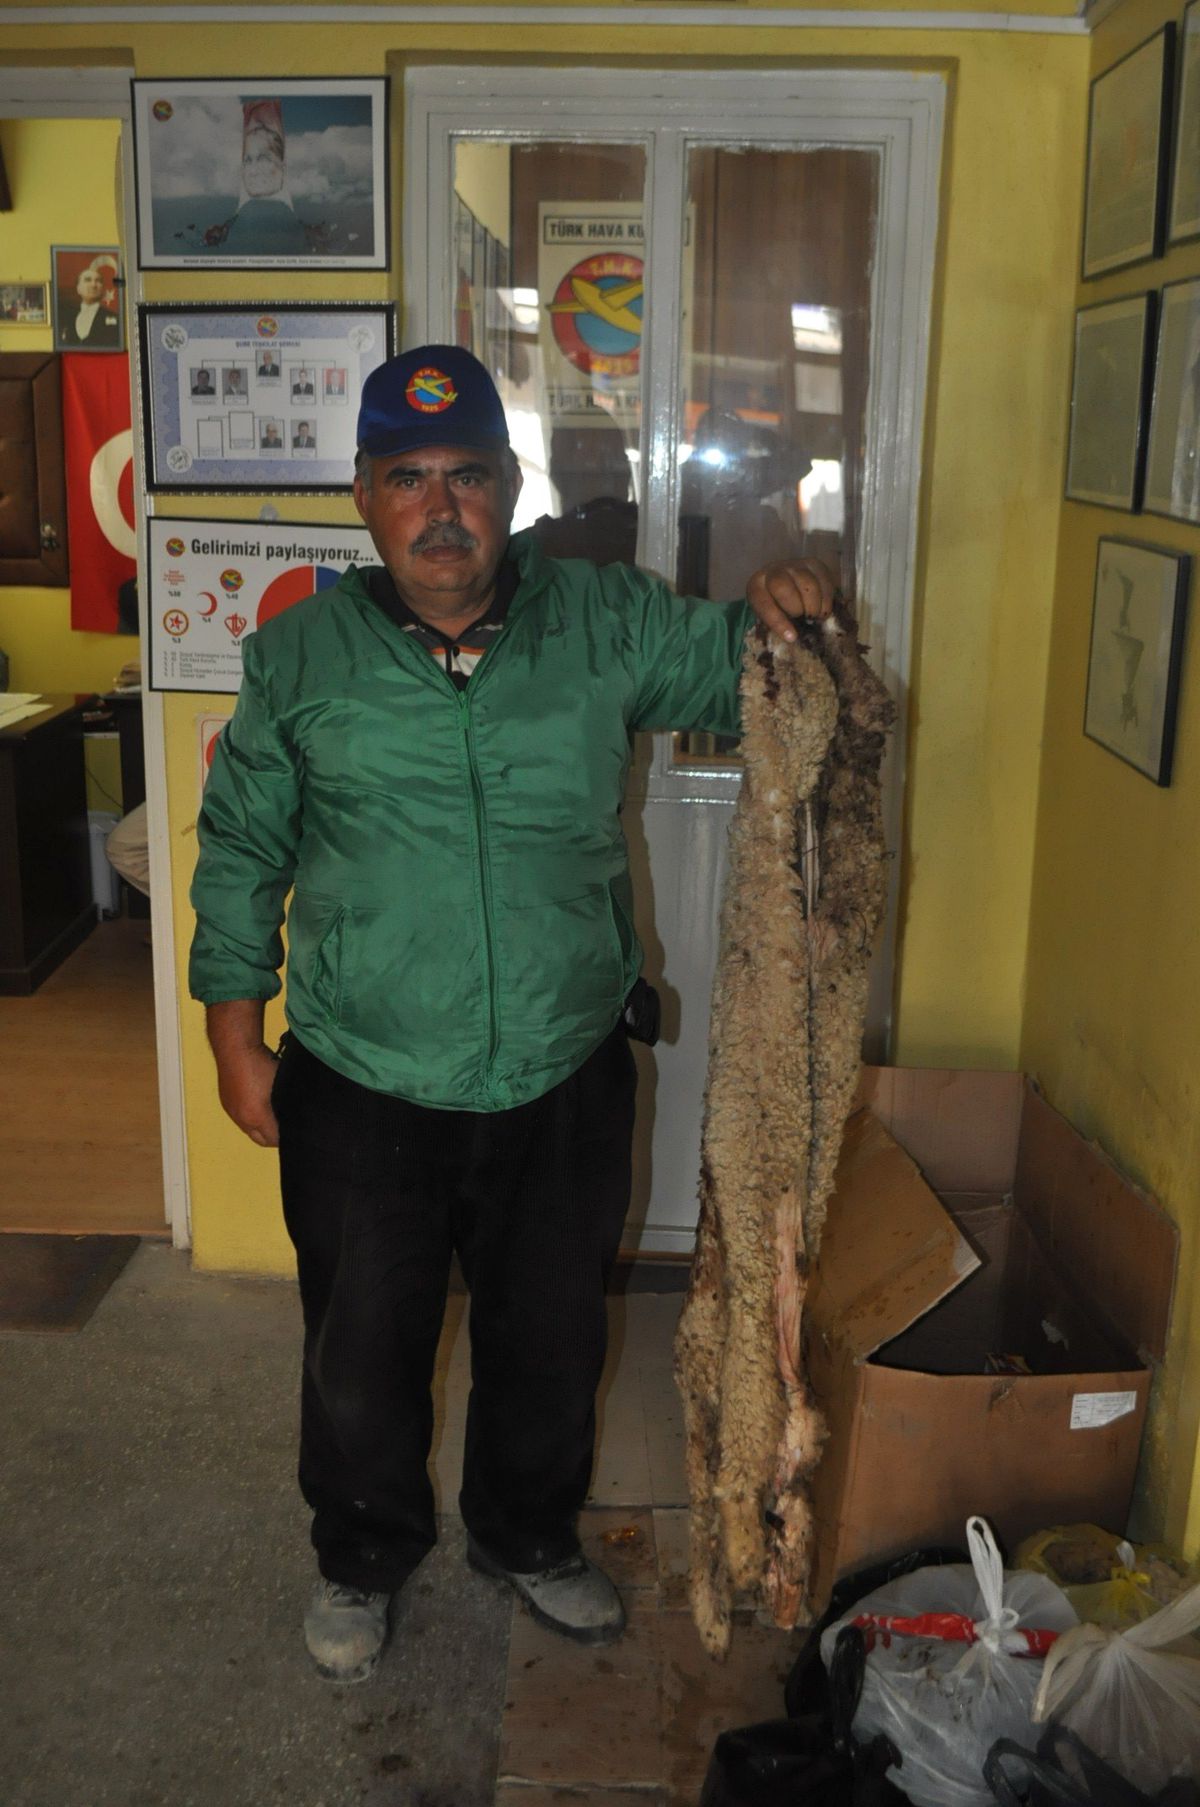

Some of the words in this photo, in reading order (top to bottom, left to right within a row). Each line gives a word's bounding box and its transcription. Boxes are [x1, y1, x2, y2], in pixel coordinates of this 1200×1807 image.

[550, 220, 583, 238] TÜRK
[588, 223, 624, 238] HAVA
[191, 538, 261, 556] Gelirimizi
